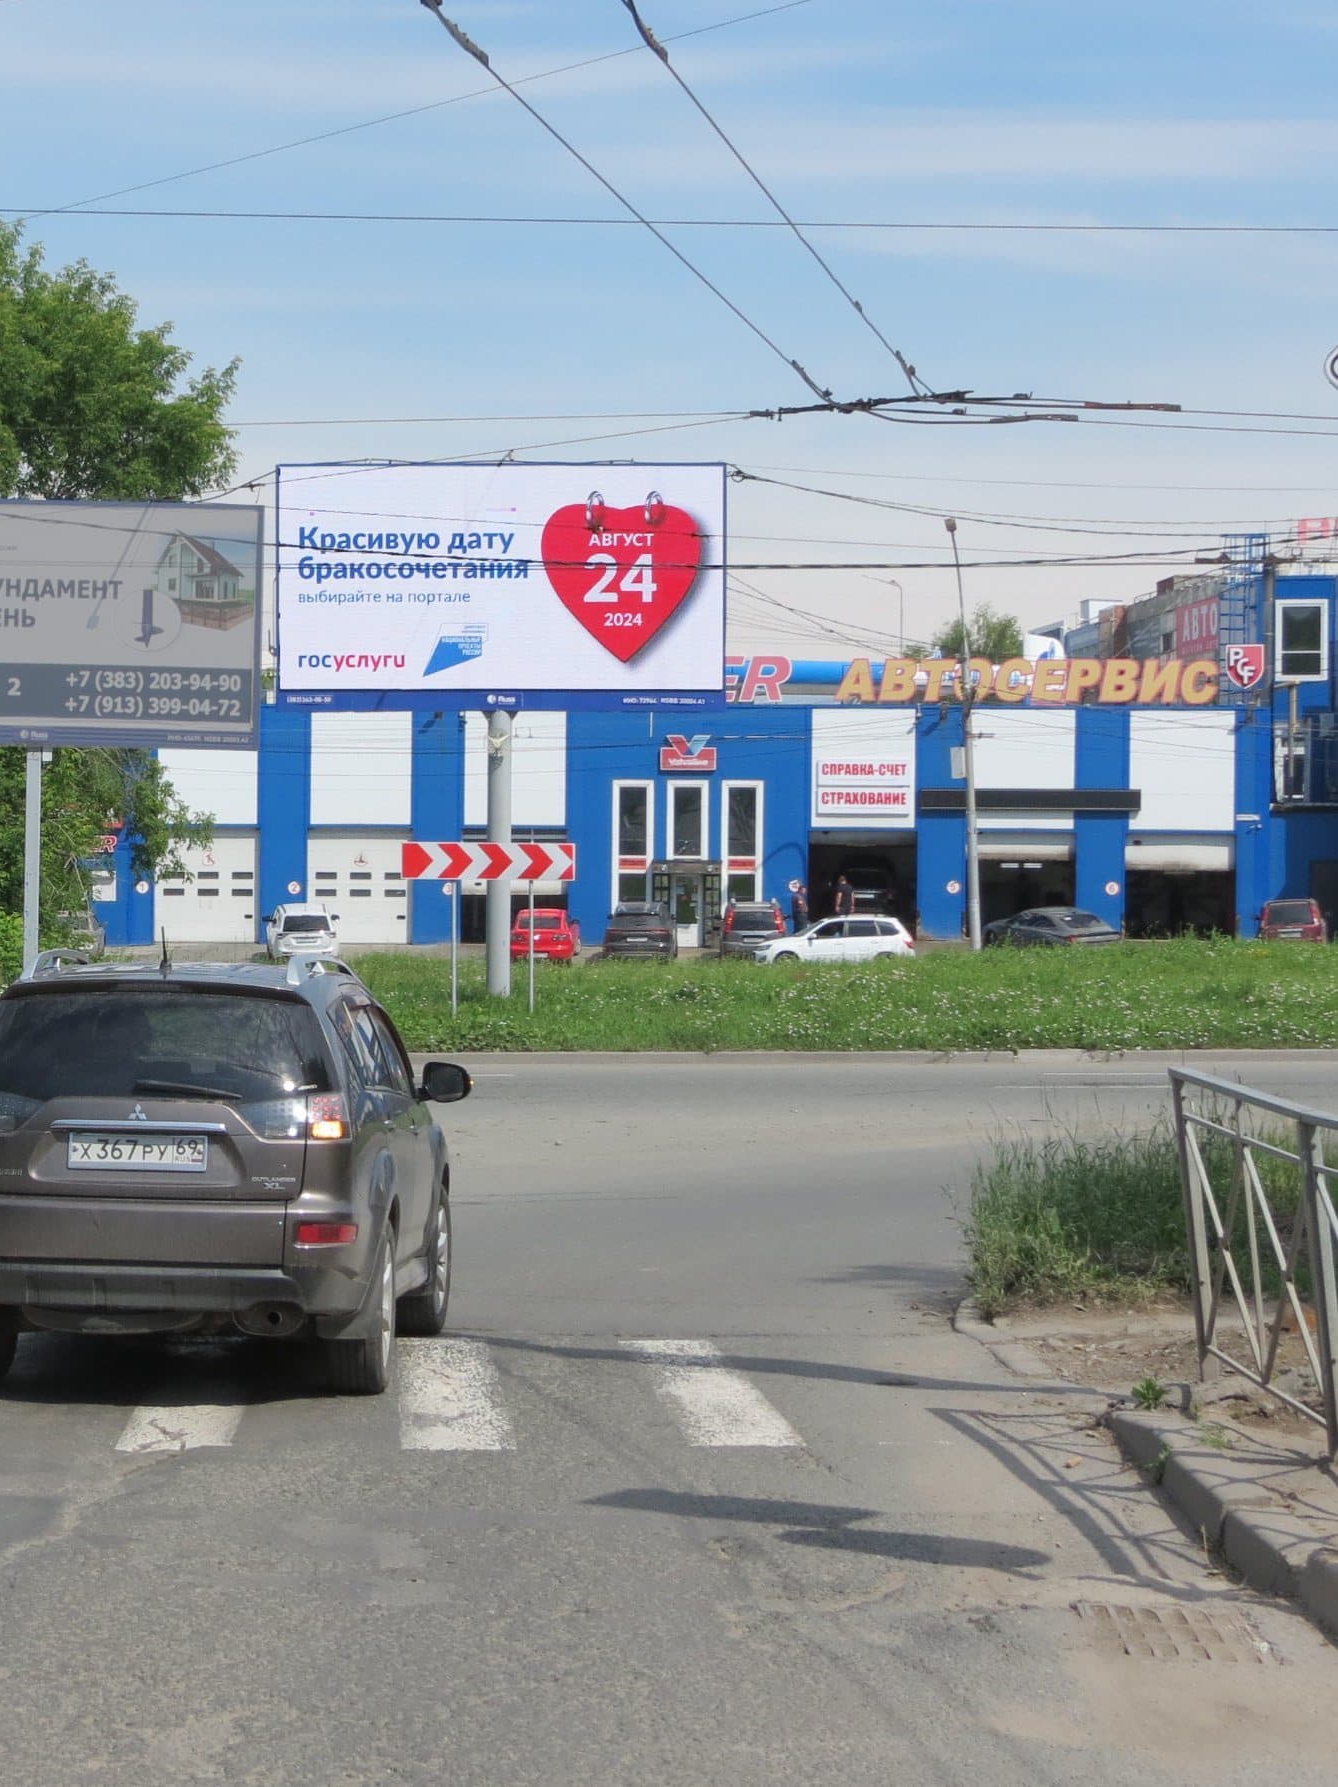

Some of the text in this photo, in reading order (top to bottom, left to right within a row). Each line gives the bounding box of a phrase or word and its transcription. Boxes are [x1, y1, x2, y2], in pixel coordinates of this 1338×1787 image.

[299, 526, 514, 554] Красивую дату
[588, 533, 655, 547] АВГУСТ
[298, 556, 529, 584] бракосочетания
[584, 553, 657, 602] 24
[298, 590, 471, 605] выбирайте на портале
[603, 612, 643, 626] 2024
[1182, 603, 1219, 643] АВТО
[298, 654, 406, 672] госуслуги
[7, 677, 22, 697] 2
[65, 671, 241, 692] +7 (383) 203-94-90
[835, 656, 1219, 704] АВТОСЕРВИС
[65, 695, 241, 717] +7 (913) 399-04-72
[821, 763, 907, 776] СПРАВКА-СЧЕТ
[821, 791, 907, 805] СТРАХОВАНИЕ
[263, 1182, 286, 1190] XL
